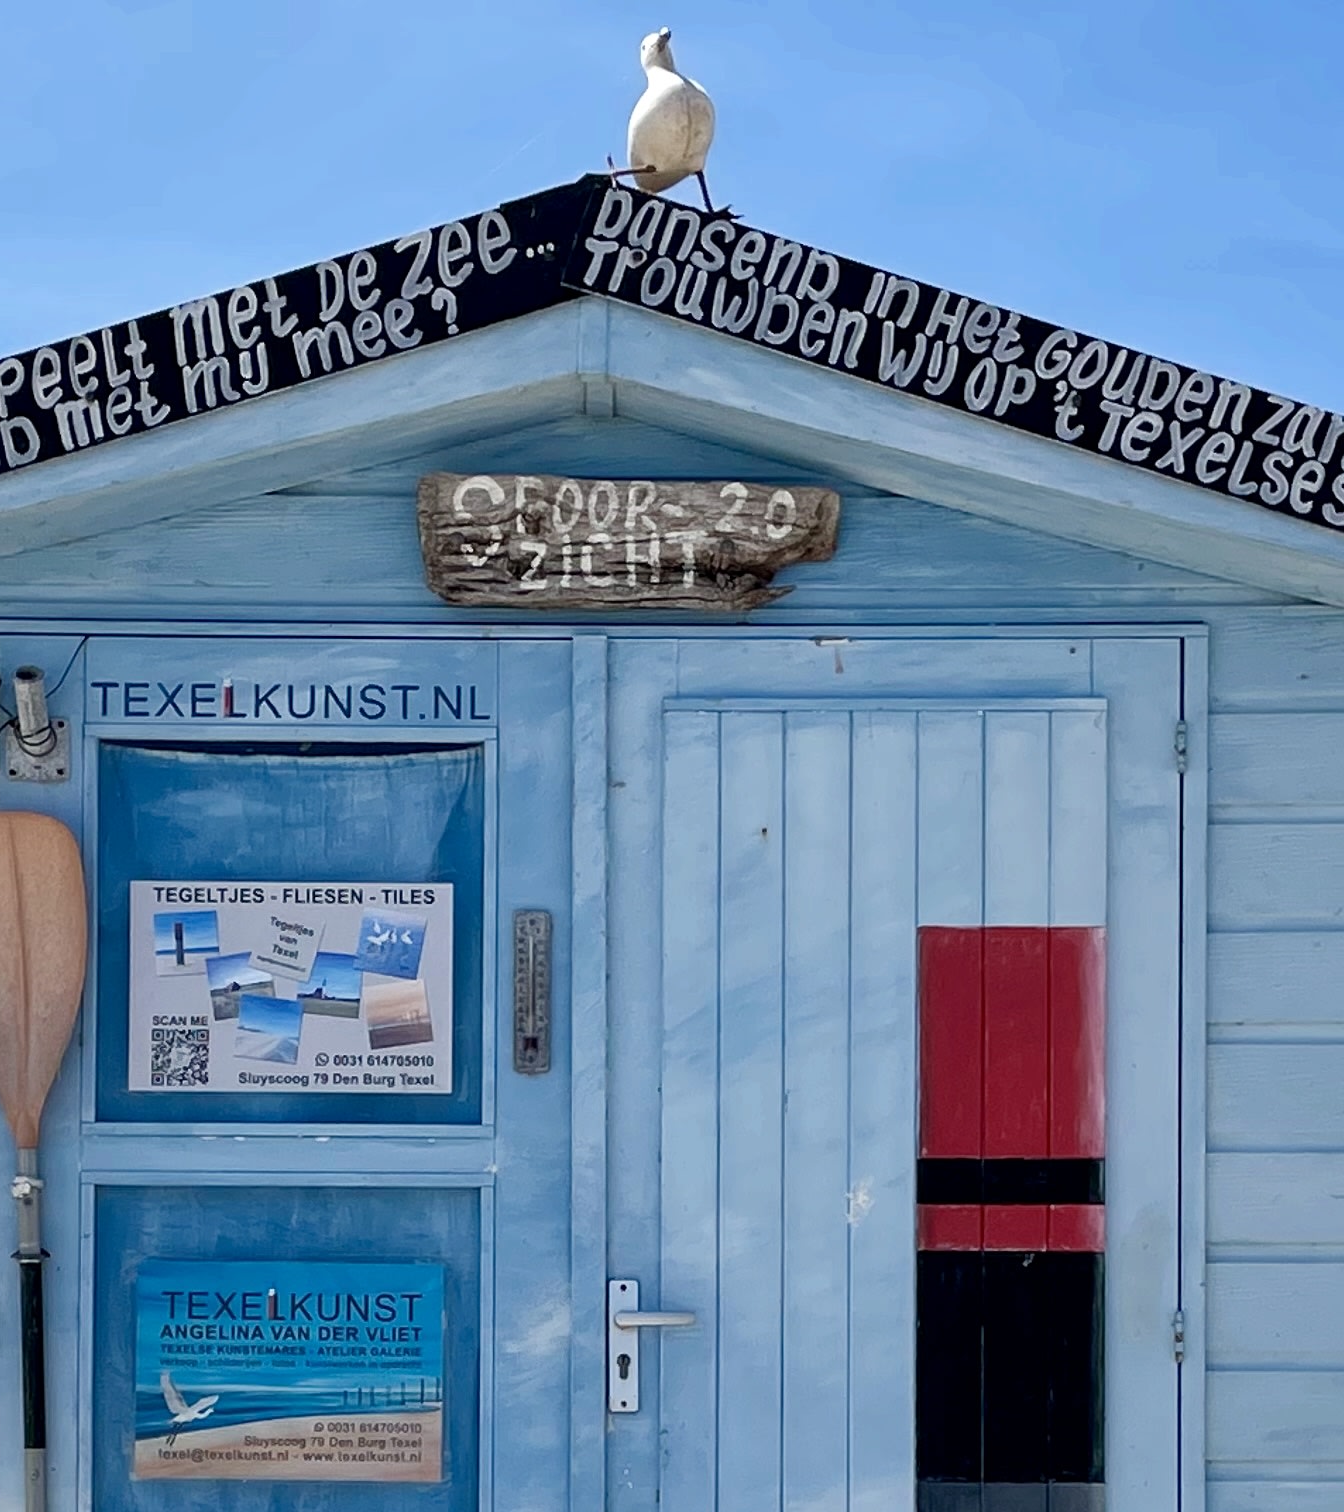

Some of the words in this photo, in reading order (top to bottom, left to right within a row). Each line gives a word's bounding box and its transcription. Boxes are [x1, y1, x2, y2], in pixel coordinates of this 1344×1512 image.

[171, 279, 299, 367] met
[54, 380, 171, 451] met
[182, 342, 269, 414] mij
[519, 530, 709, 590] ZICHT
[90, 679, 491, 720] TEXELKUNST.NL
[154, 887, 265, 905] TEGELTJES
[283, 888, 363, 905] FLIESEN
[381, 889, 435, 905] TILES
[153, 1015, 182, 1026] SCAN
[187, 1015, 208, 1026] ME
[333, 1055, 363, 1067] 0031
[239, 1072, 309, 1087] Sluyscoog
[313, 1073, 329, 1085] 79
[333, 1073, 359, 1085] Den
[363, 1073, 395, 1088] Burg
[399, 1073, 435, 1085] Texel
[160, 1290, 423, 1322] TEXELKUNST
[160, 1324, 264, 1341] ANGELINA
[270, 1325, 310, 1341] VAN
[318, 1325, 359, 1341] DER
[365, 1326, 423, 1342] VLIET
[327, 1422, 355, 1434] 0031
[329, 1437, 354, 1448] Den
[358, 1437, 386, 1450] Burg
[390, 1437, 422, 1448] Texel
